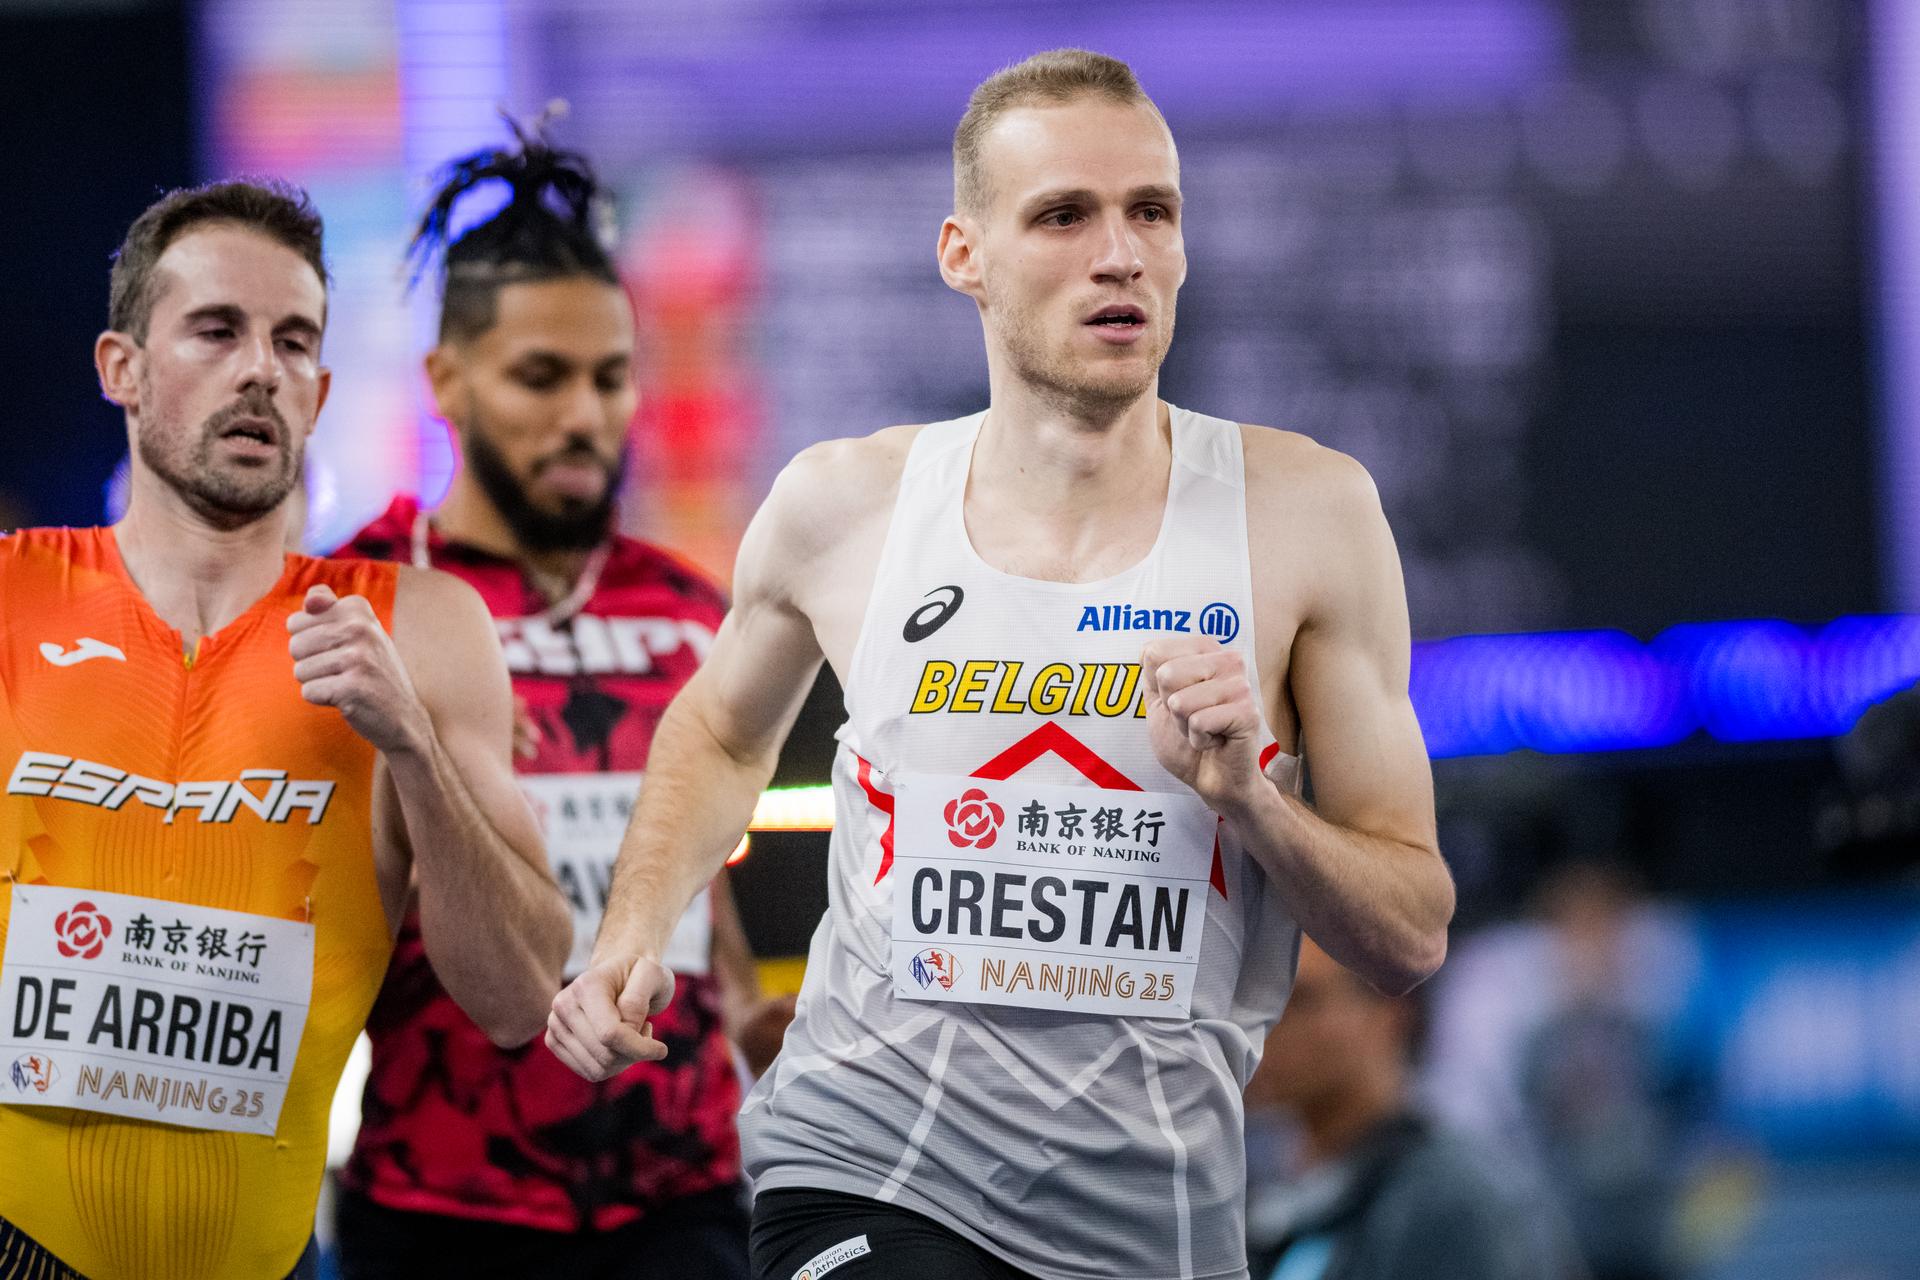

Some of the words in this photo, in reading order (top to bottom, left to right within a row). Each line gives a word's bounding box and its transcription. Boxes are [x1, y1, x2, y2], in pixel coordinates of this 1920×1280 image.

[1077, 604, 1191, 632] Allianz
[909, 660, 1147, 719] BELGIU
[7, 751, 336, 825] ESPAÑA
[1017, 799, 1166, 848] 南京银行
[1017, 840, 1061, 855] BANK
[1067, 845, 1087, 856] OF
[1093, 847, 1161, 863] NANJING
[911, 867, 1189, 952] CRESTAN
[124, 913, 268, 969] 南京银行
[121, 951, 165, 969] BANK
[170, 960, 190, 972] OF
[195, 963, 261, 984] NANJING
[980, 957, 1136, 1001] NANJING
[1140, 973, 1175, 1001] 25
[13, 976, 77, 1041] DE
[87, 984, 283, 1073] ARRIBA
[76, 1064, 228, 1113] NANJING
[230, 1089, 265, 1118] 25
[815, 1245, 866, 1277] Athletics
